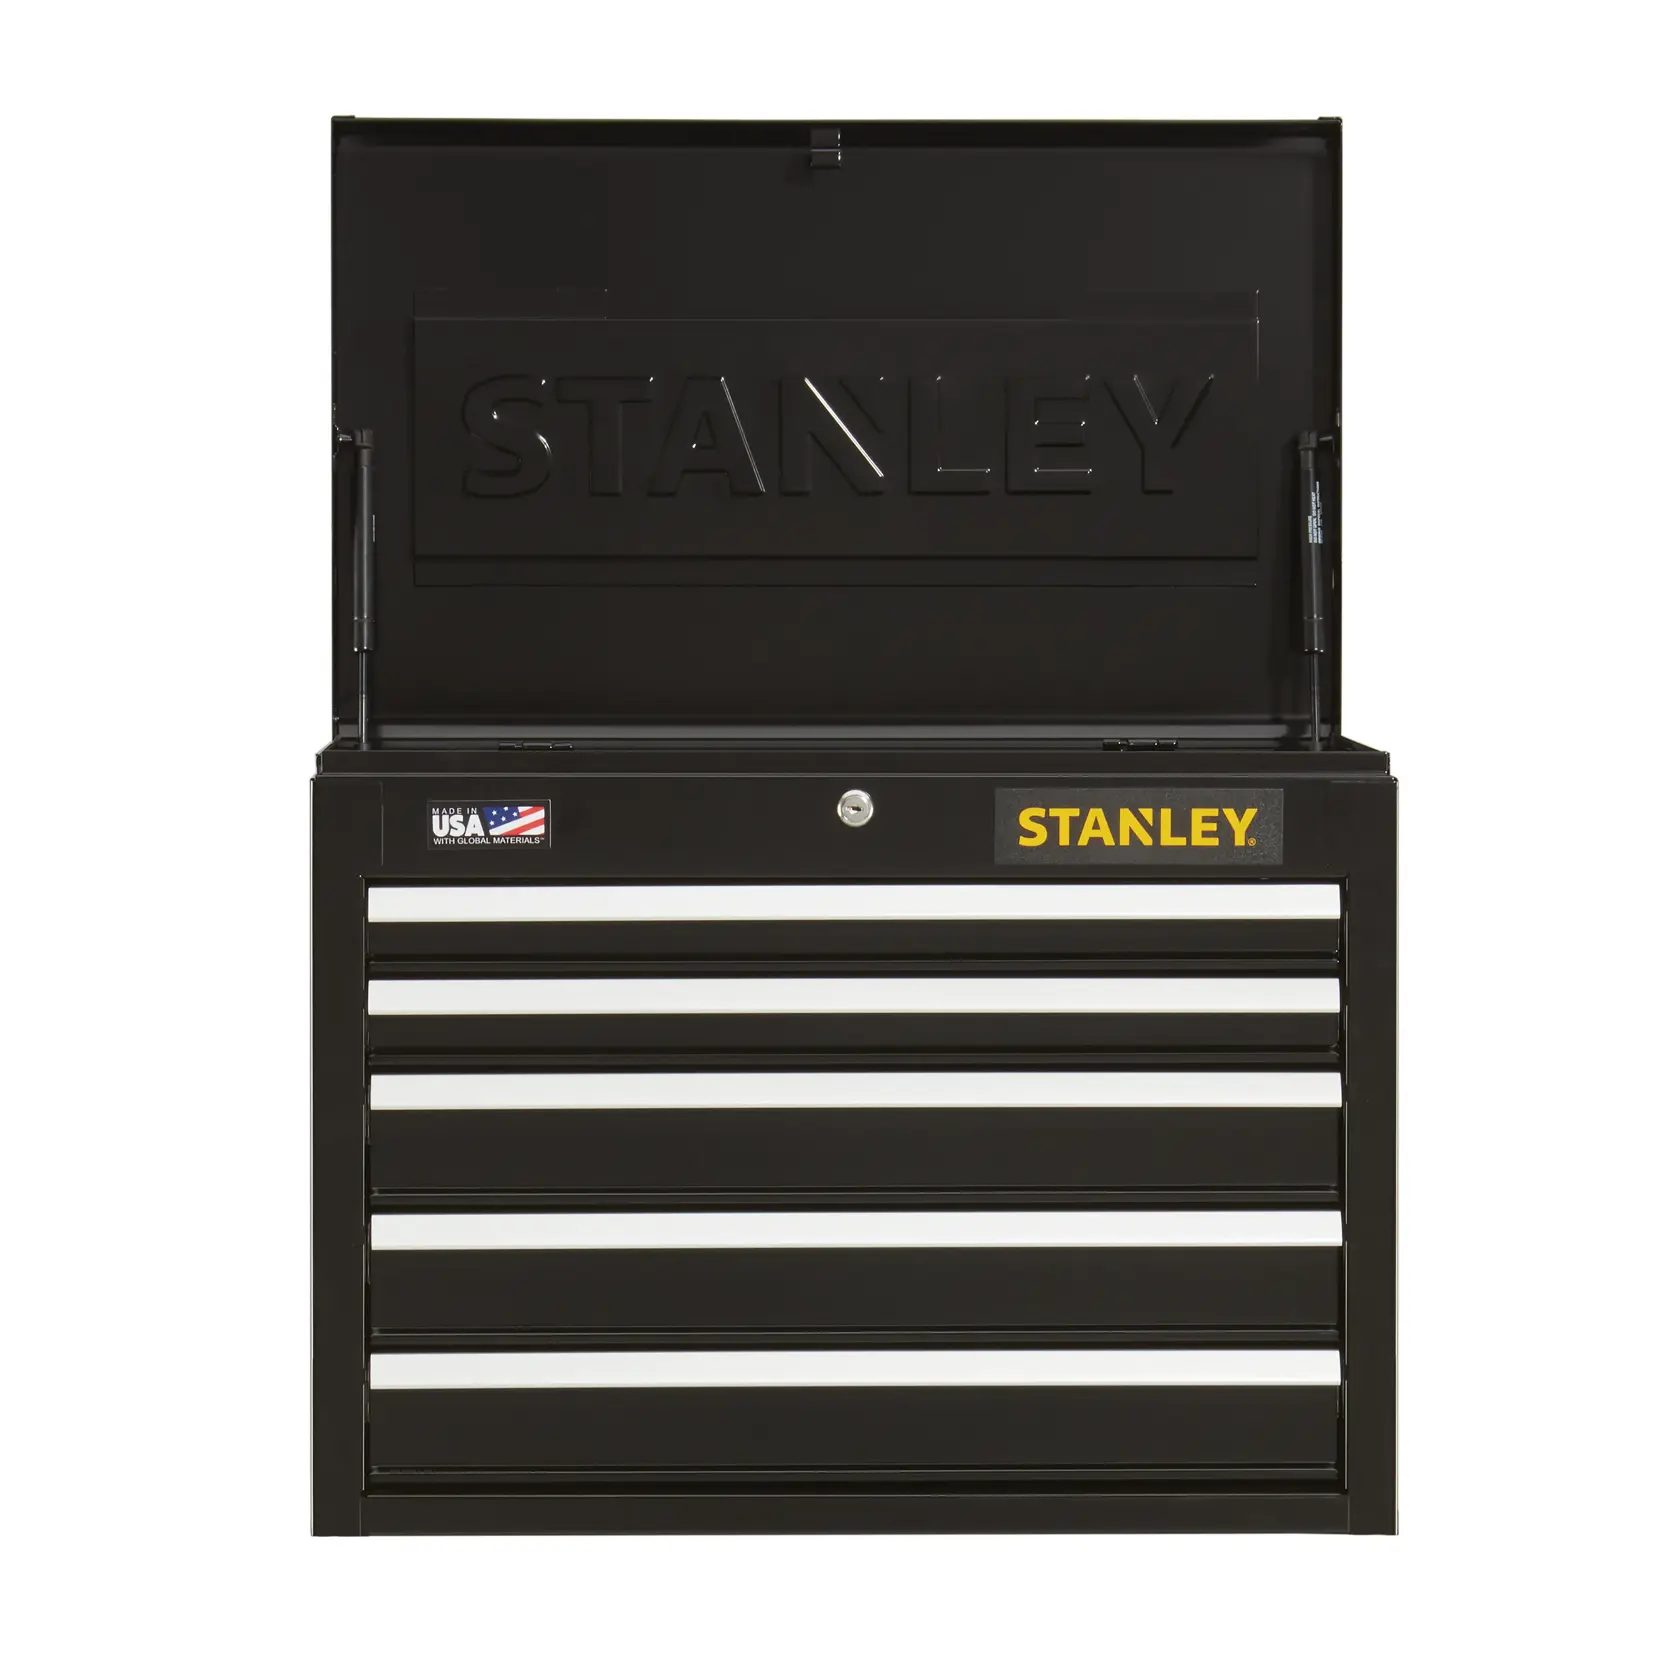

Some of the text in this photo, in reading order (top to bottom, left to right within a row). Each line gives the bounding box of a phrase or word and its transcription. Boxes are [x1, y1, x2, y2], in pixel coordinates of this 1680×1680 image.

[462, 374, 1216, 498] STANLEY
[432, 807, 477, 815] MADE IN
[432, 814, 485, 837] USA
[457, 837, 491, 845] GLOBAL
